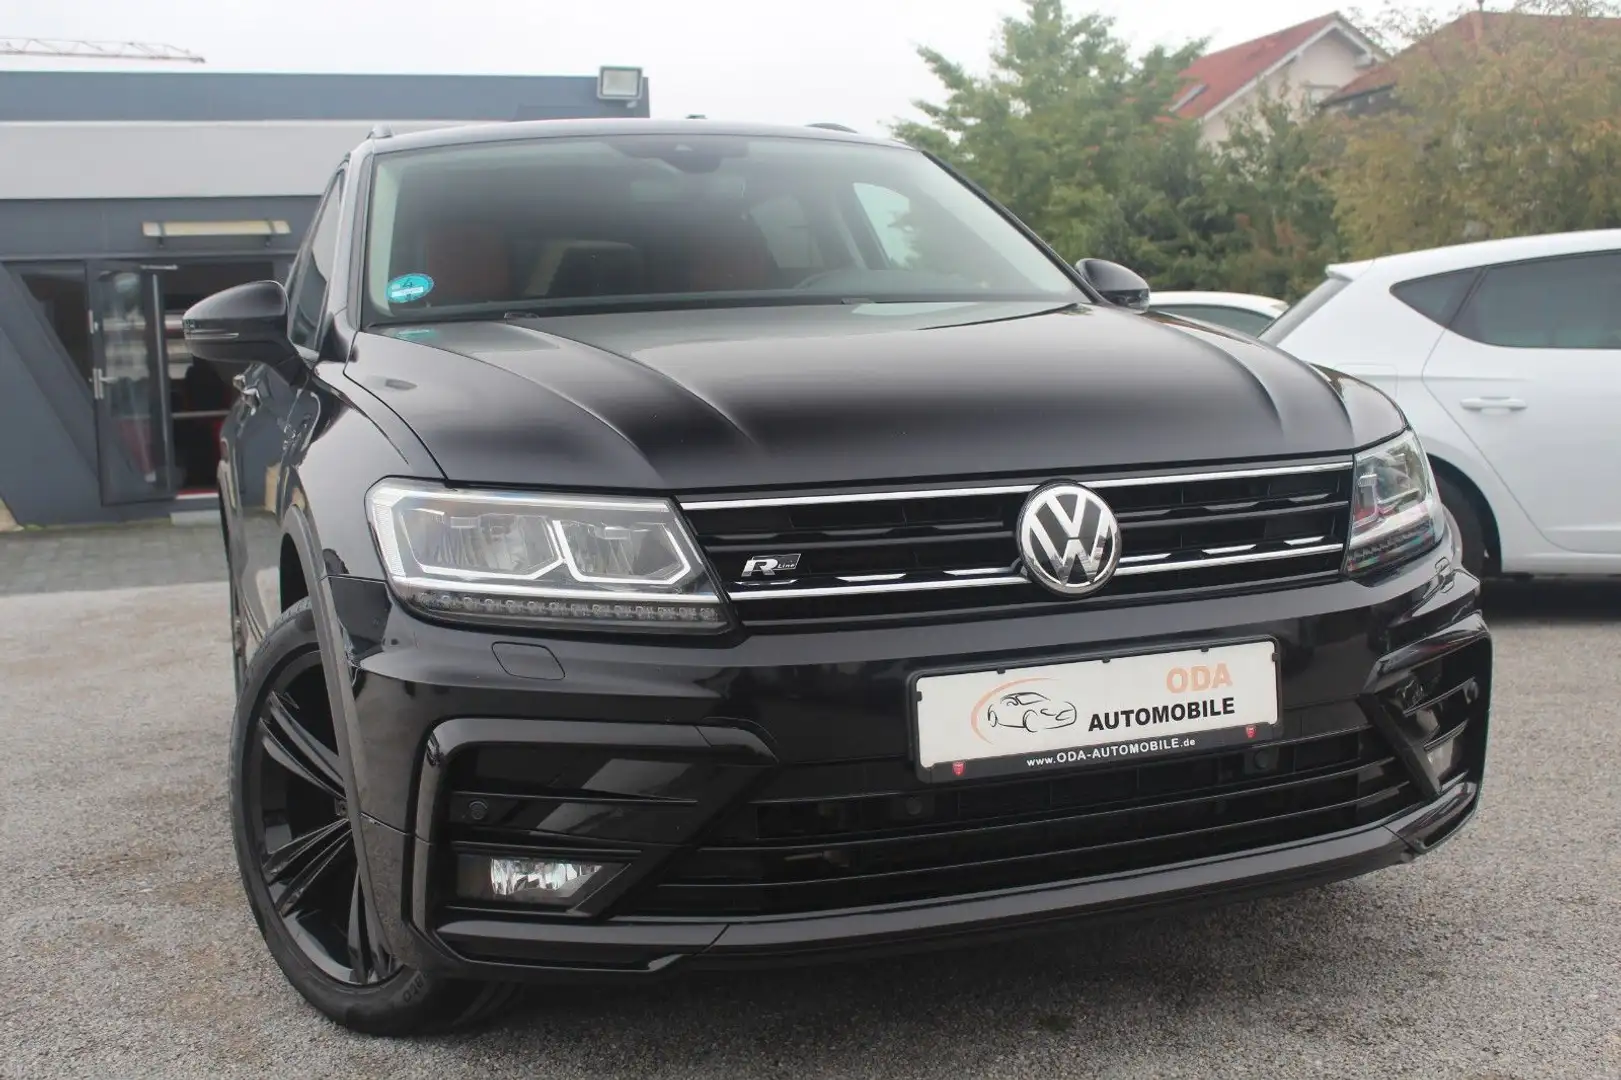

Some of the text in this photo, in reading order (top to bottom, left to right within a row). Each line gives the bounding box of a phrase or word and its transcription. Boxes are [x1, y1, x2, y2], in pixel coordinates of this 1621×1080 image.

[1022, 487, 1118, 590] VW
[741, 558, 778, 577] R
[1166, 663, 1233, 694] ODA
[1088, 697, 1235, 732] AUTOMOBILE
[1026, 737, 1196, 767] www.ODA-AUTOMOBILE.de
